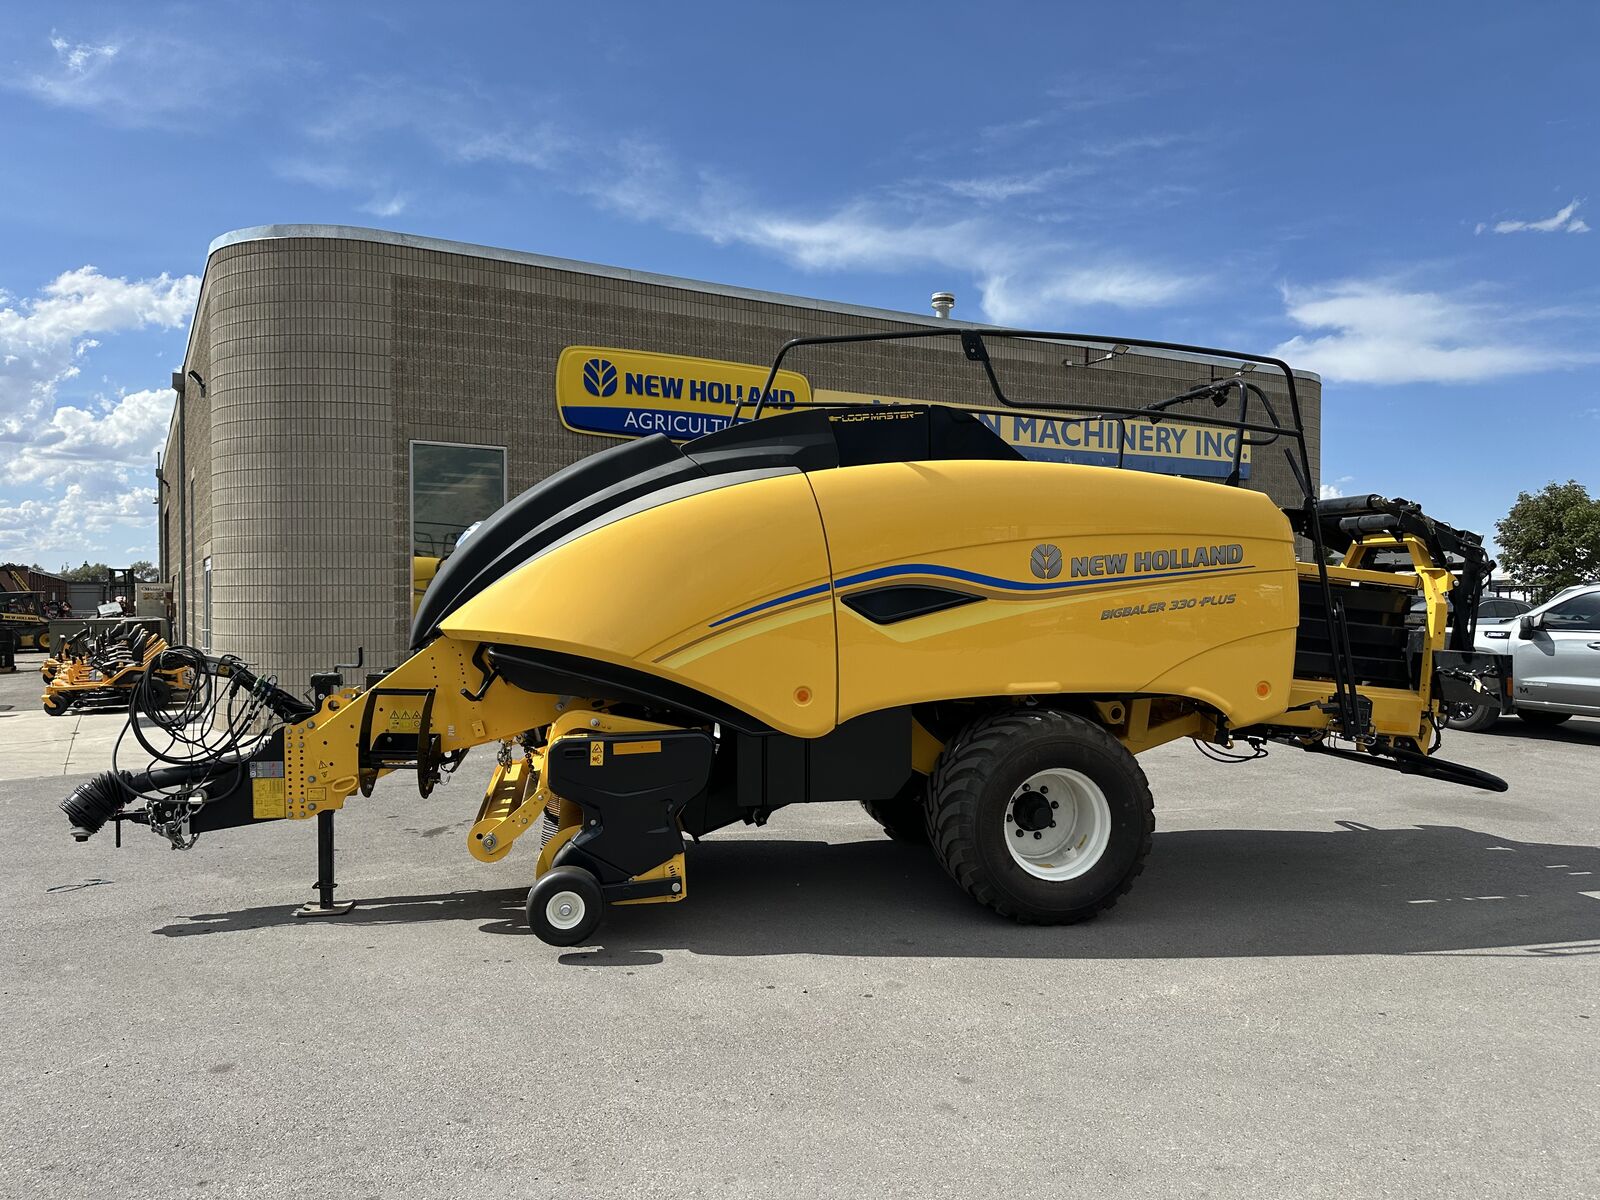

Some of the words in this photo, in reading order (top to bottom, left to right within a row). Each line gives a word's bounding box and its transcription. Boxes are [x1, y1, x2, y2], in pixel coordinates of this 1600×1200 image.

[625, 372, 684, 399] NEW
[690, 380, 795, 410] HOLLAND
[624, 411, 745, 434] AGRICULT
[1013, 416, 1188, 454] MACHINERY
[1071, 553, 1128, 577] NEW
[1134, 544, 1243, 572] HOLLAND
[1100, 602, 1166, 620] BIGBALER
[1169, 598, 1197, 610] 330
